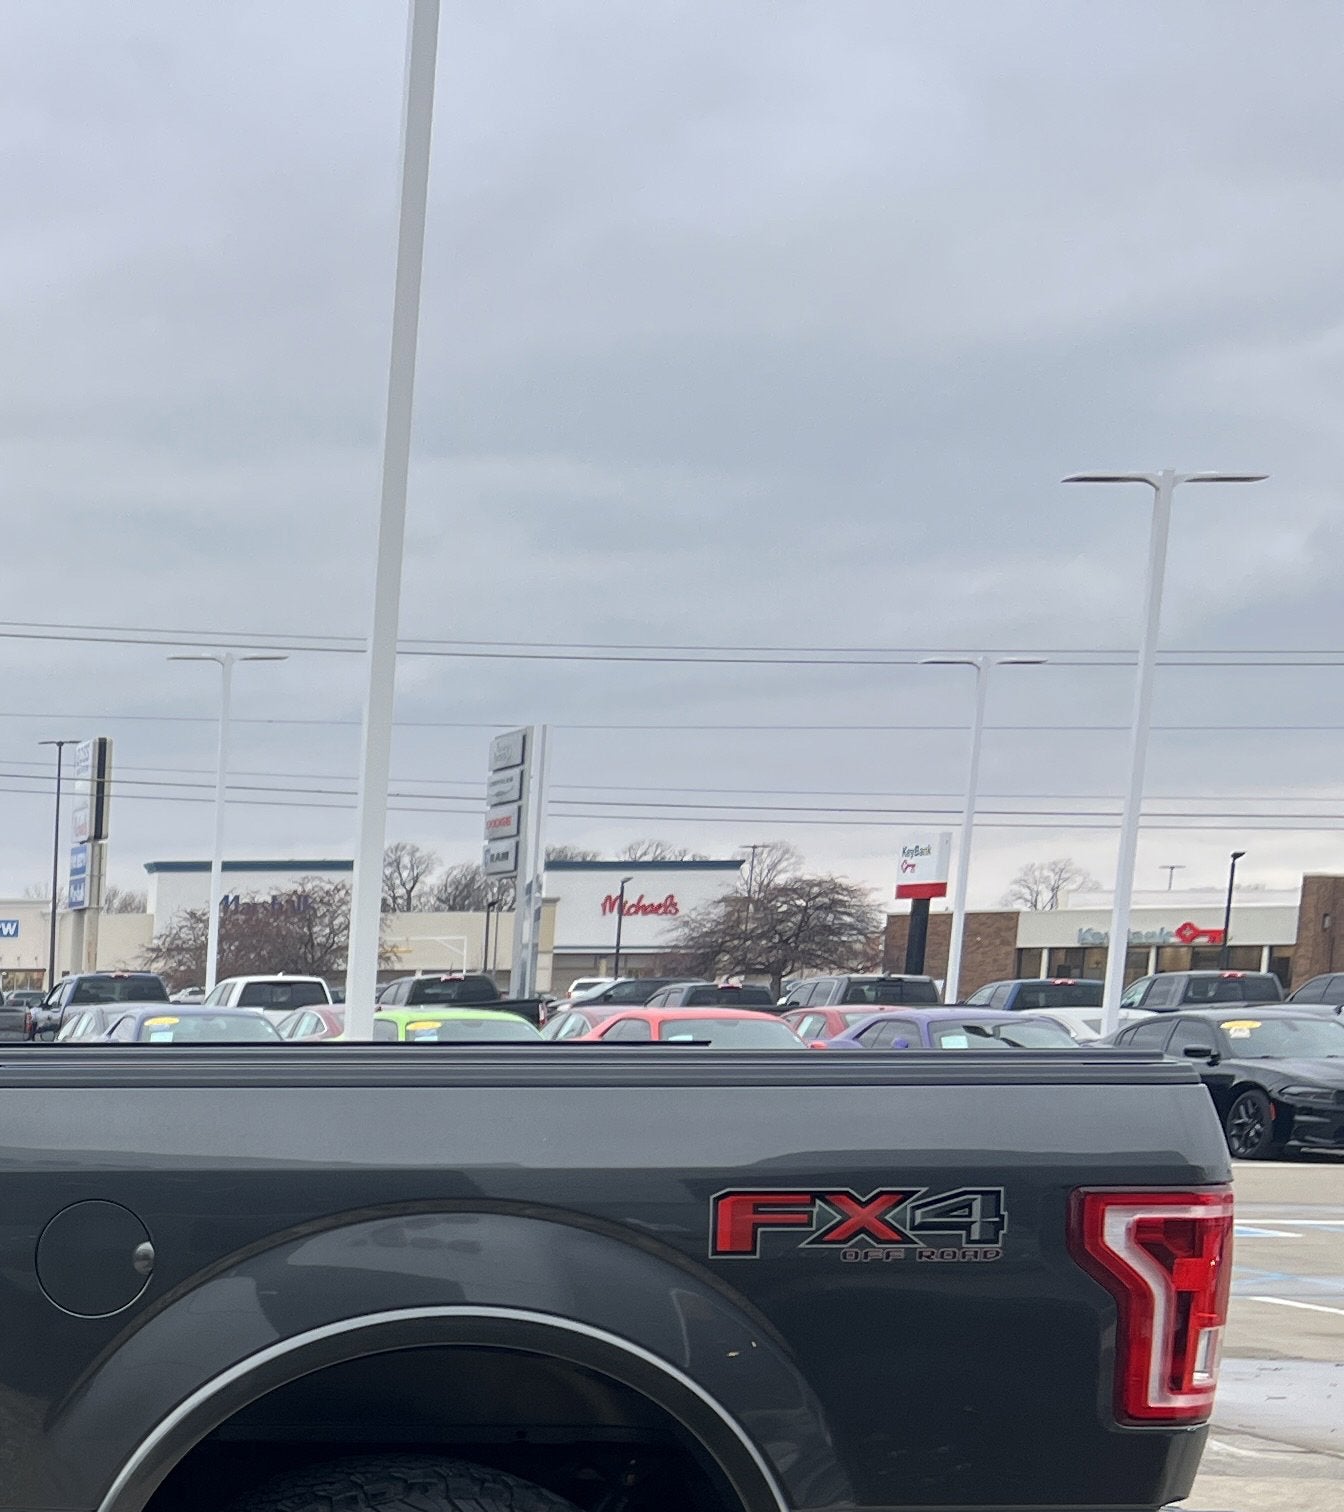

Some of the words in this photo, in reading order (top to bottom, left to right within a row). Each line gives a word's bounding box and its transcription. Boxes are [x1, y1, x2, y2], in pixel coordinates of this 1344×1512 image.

[601, 894, 679, 916] Michaels
[1078, 927, 1175, 946] Keank
[709, 1187, 1008, 1259] FX4
[840, 1248, 905, 1263] OFF
[916, 1247, 1003, 1262] ROAD
